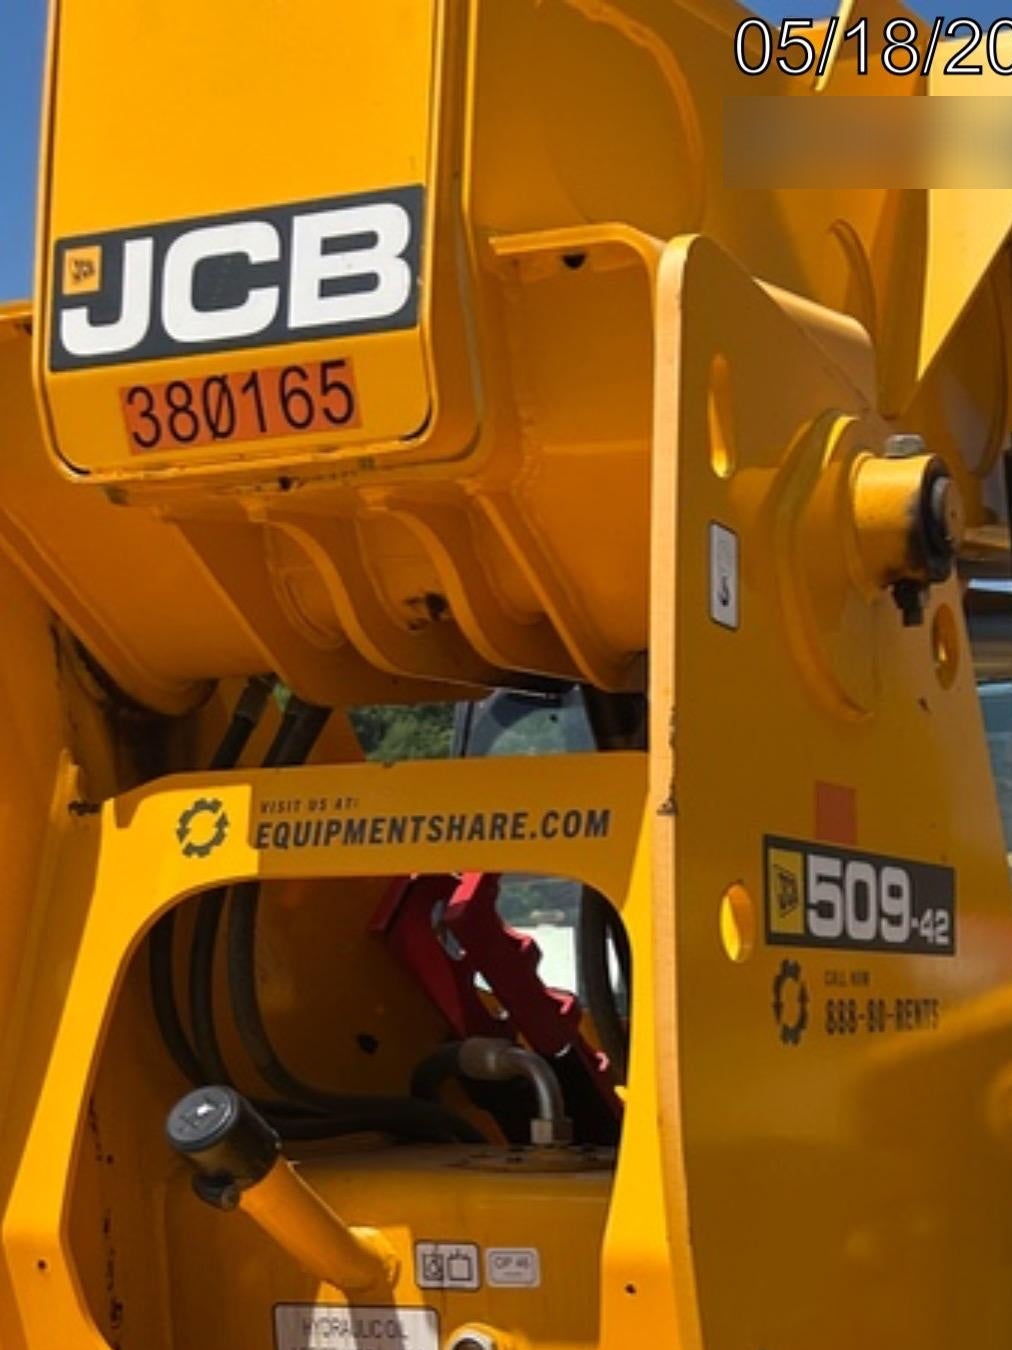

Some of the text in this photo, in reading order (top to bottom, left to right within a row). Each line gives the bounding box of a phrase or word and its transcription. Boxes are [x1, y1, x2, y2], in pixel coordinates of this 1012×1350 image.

[60, 203, 411, 357] JCB
[126, 359, 355, 448] 380165
[255, 810, 611, 850] EQUIPMENTSHARE.COM
[261, 799, 301, 813] VISIT
[308, 797, 329, 811] US
[808, 854, 949, 945] 509-42
[302, 1316, 408, 1339] HYDRAULIC OIL
